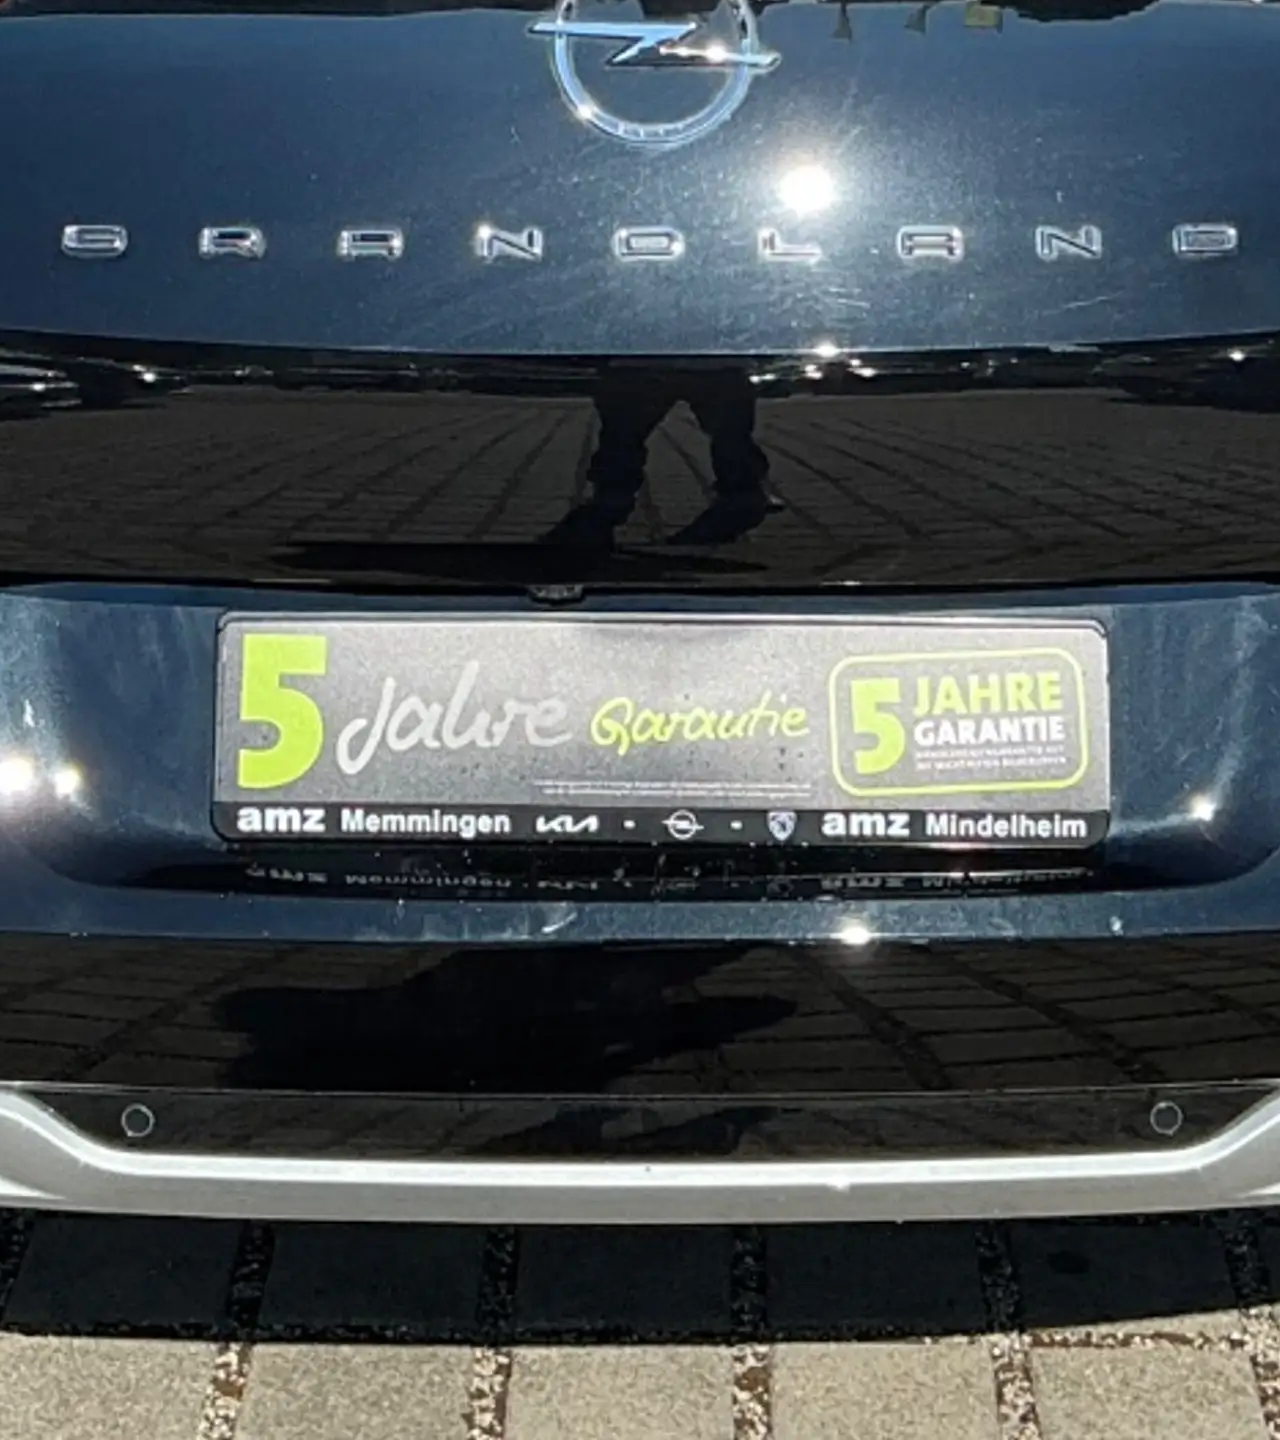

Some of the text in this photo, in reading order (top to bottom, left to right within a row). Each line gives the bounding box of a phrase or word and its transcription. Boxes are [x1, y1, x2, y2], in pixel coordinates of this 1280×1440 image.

[61, 221, 1239, 261] GRANDLAND
[237, 633, 810, 789] 5 Jahre Garantie
[851, 671, 1064, 775] 5 JAHRE
[913, 715, 1066, 746] GARANTIE
[236, 806, 327, 833] amz
[340, 808, 511, 839] Memmingen
[821, 811, 911, 837] amz
[924, 813, 1088, 838] Mindelheim
